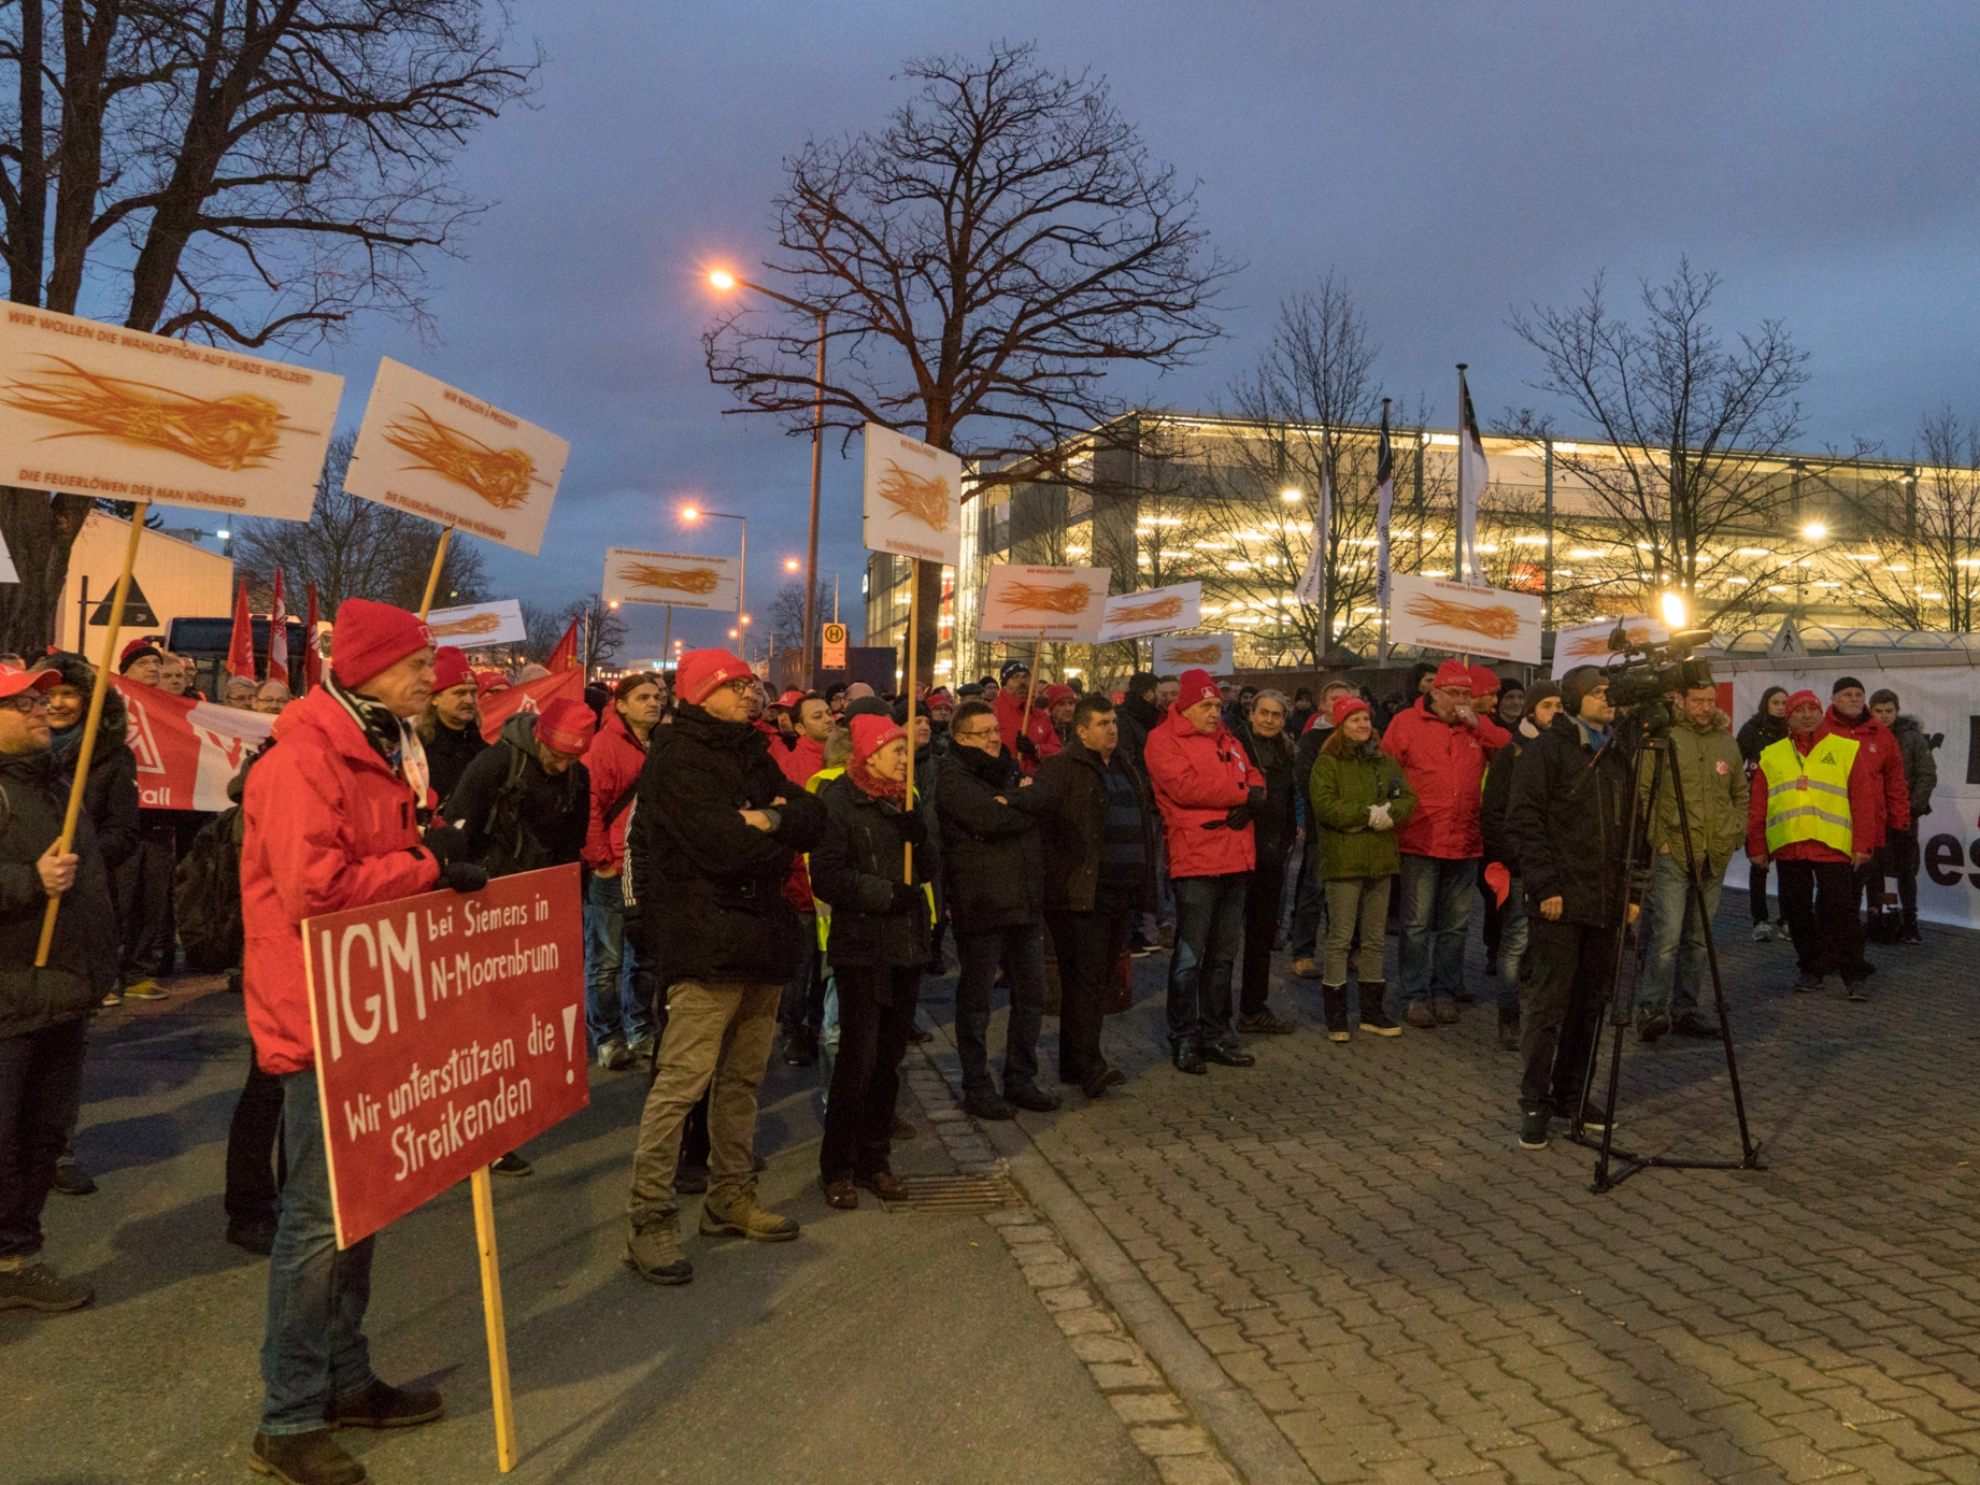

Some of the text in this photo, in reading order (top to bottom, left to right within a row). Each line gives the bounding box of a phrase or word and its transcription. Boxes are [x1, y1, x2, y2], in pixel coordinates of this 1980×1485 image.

[8, 310, 35, 326] WIR
[39, 317, 94, 339] WOLLEN
[97, 329, 117, 344] DIE
[121, 335, 200, 362] WAHLOPTION
[202, 353, 225, 366] AUF
[228, 358, 262, 375] KURZE
[19, 468, 246, 508] DIE FEUERLÖWEN DER MAN NÜRNBERG
[427, 893, 549, 941] bei Siemens in
[321, 911, 427, 1062] IGM
[431, 938, 559, 1001] N-Moorenbrunn
[344, 1093, 382, 1142] Wir
[388, 1037, 515, 1120] unterstützen
[528, 1012, 555, 1056] die
[391, 1076, 533, 1181] Streikenden
